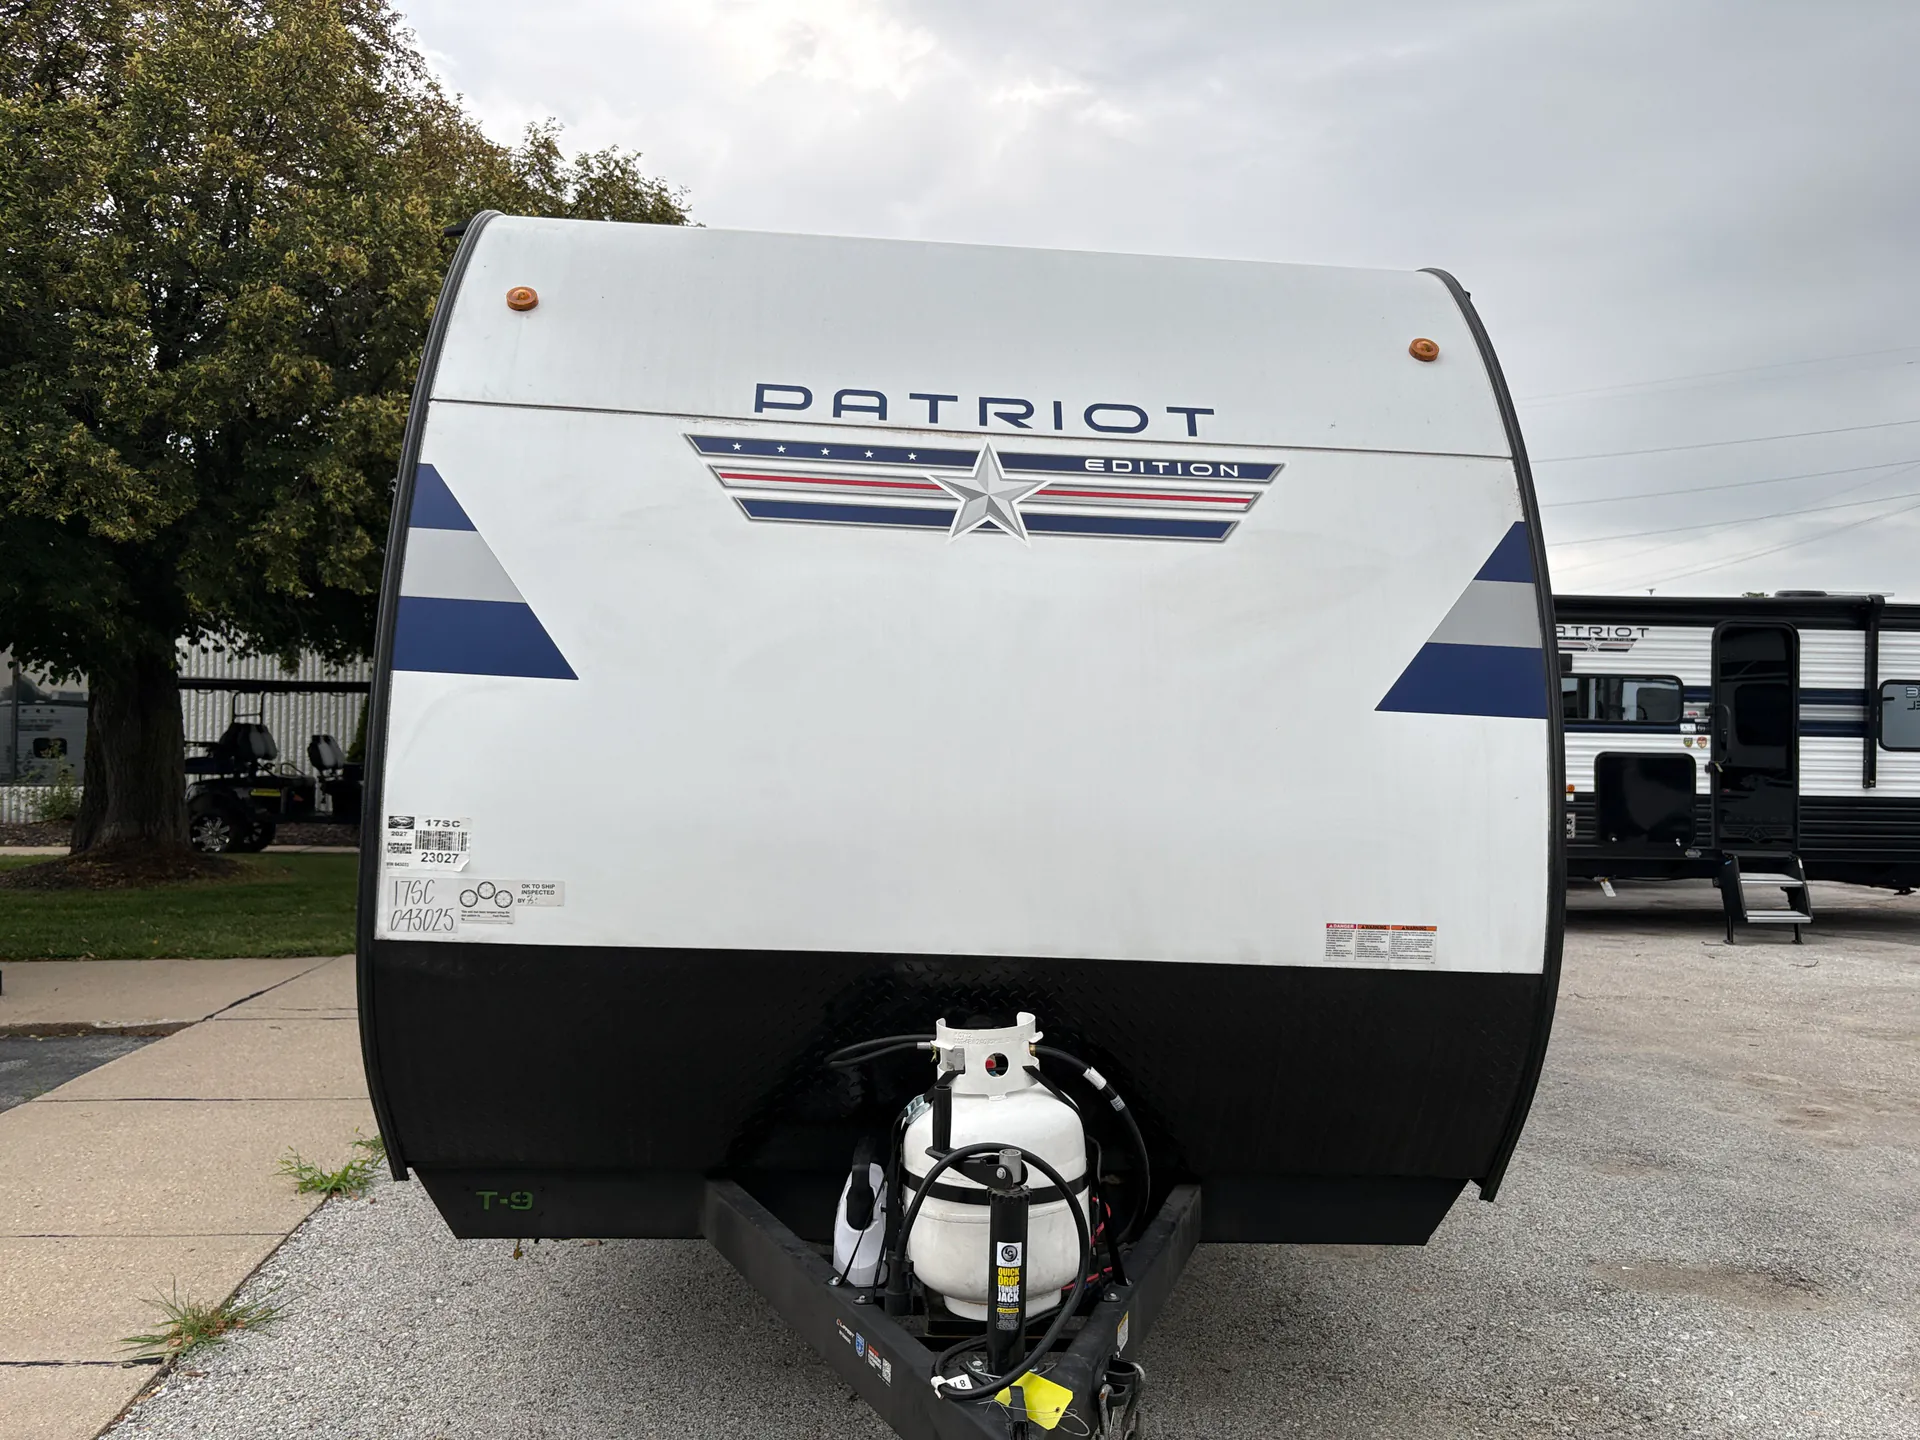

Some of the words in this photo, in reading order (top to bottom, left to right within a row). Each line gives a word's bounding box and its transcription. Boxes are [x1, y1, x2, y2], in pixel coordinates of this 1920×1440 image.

[754, 382, 1215, 437] PATRIOT
[1084, 457, 1240, 478] EDITION
[425, 819, 461, 828] 17SC
[421, 852, 460, 864] 23027
[394, 879, 436, 907] 17SC
[390, 908, 455, 932] 043025
[475, 1190, 534, 1211] T-9
[998, 1267, 1020, 1276] QUICK
[997, 1275, 1020, 1286] DROP
[997, 1285, 1020, 1294] TONGUE
[997, 1292, 1020, 1303] JACK
